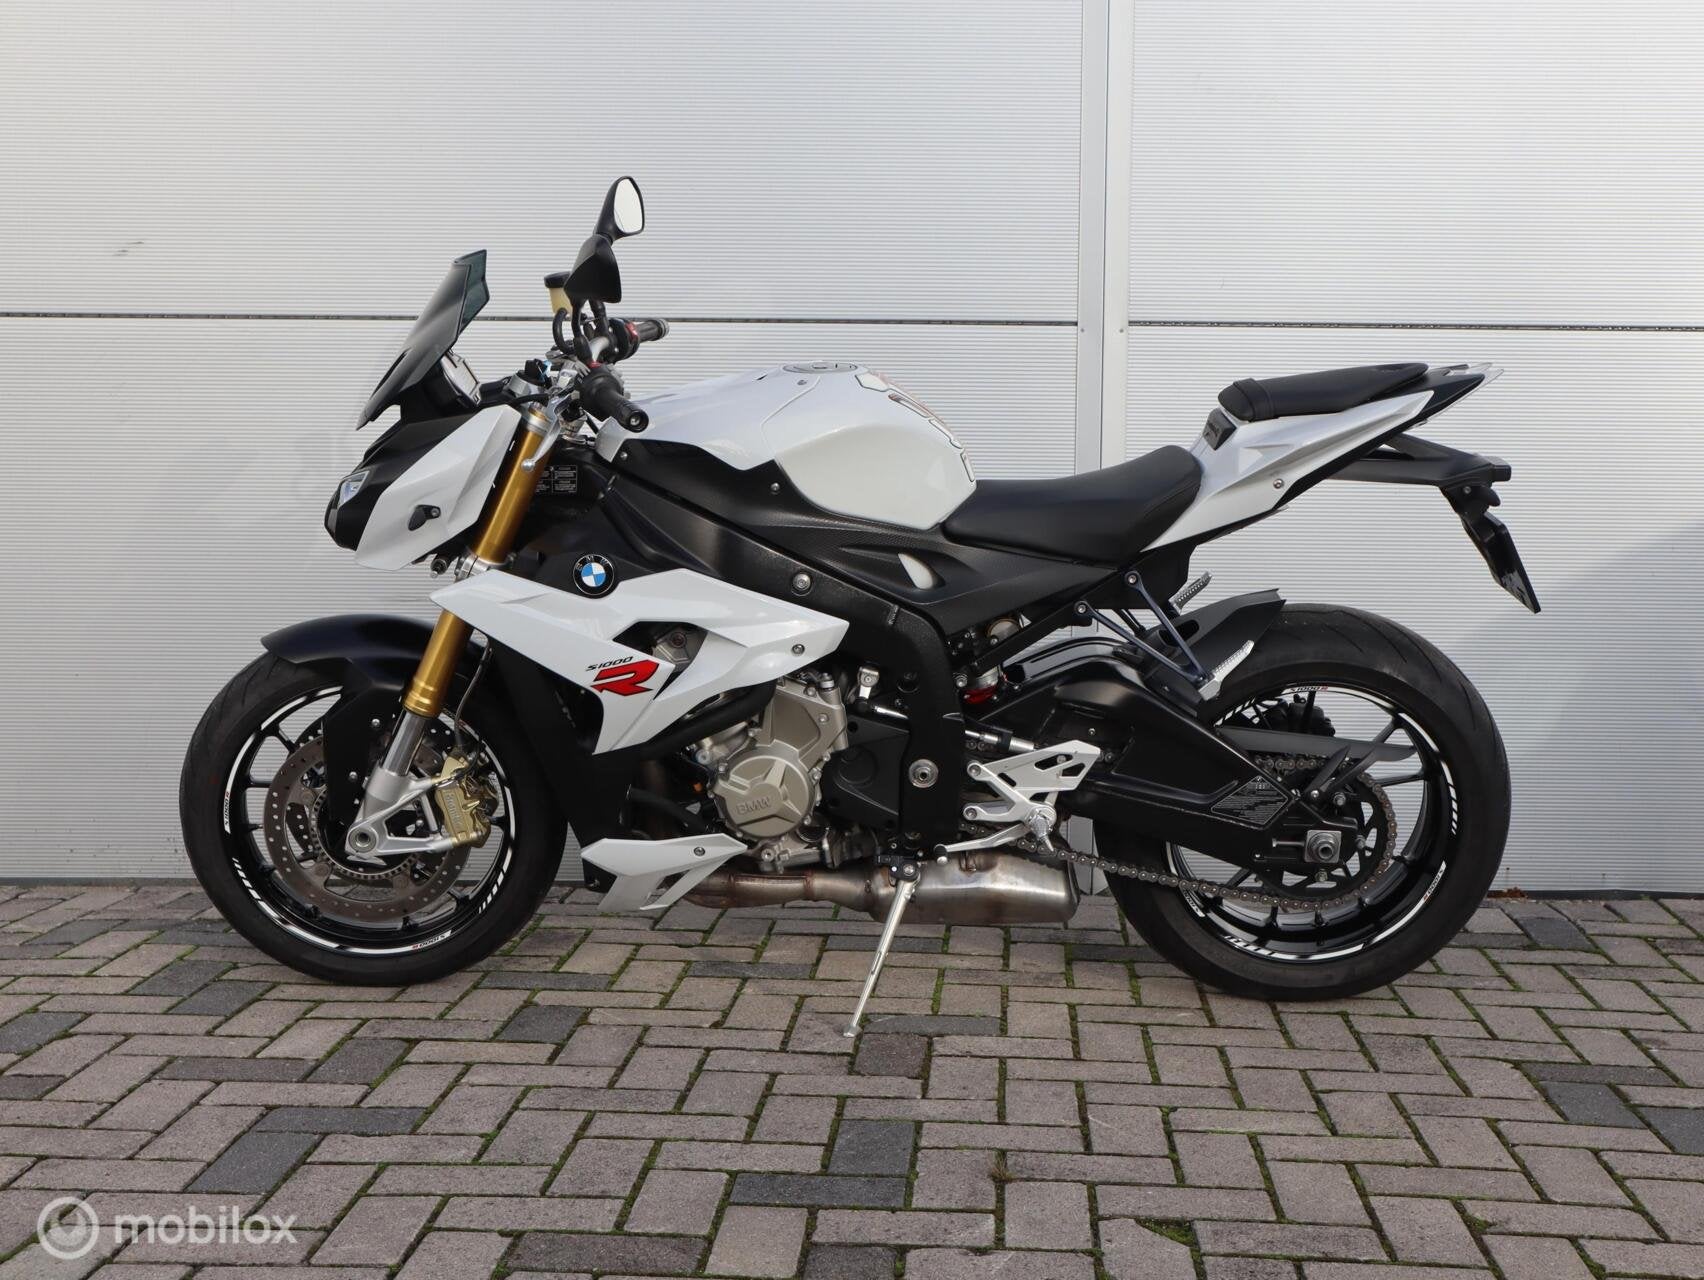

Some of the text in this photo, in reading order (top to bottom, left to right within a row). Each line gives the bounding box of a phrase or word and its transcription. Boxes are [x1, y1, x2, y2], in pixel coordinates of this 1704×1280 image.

[585, 656, 633, 671] S1000
[590, 660, 659, 696] R
[736, 796, 771, 815] BMW
